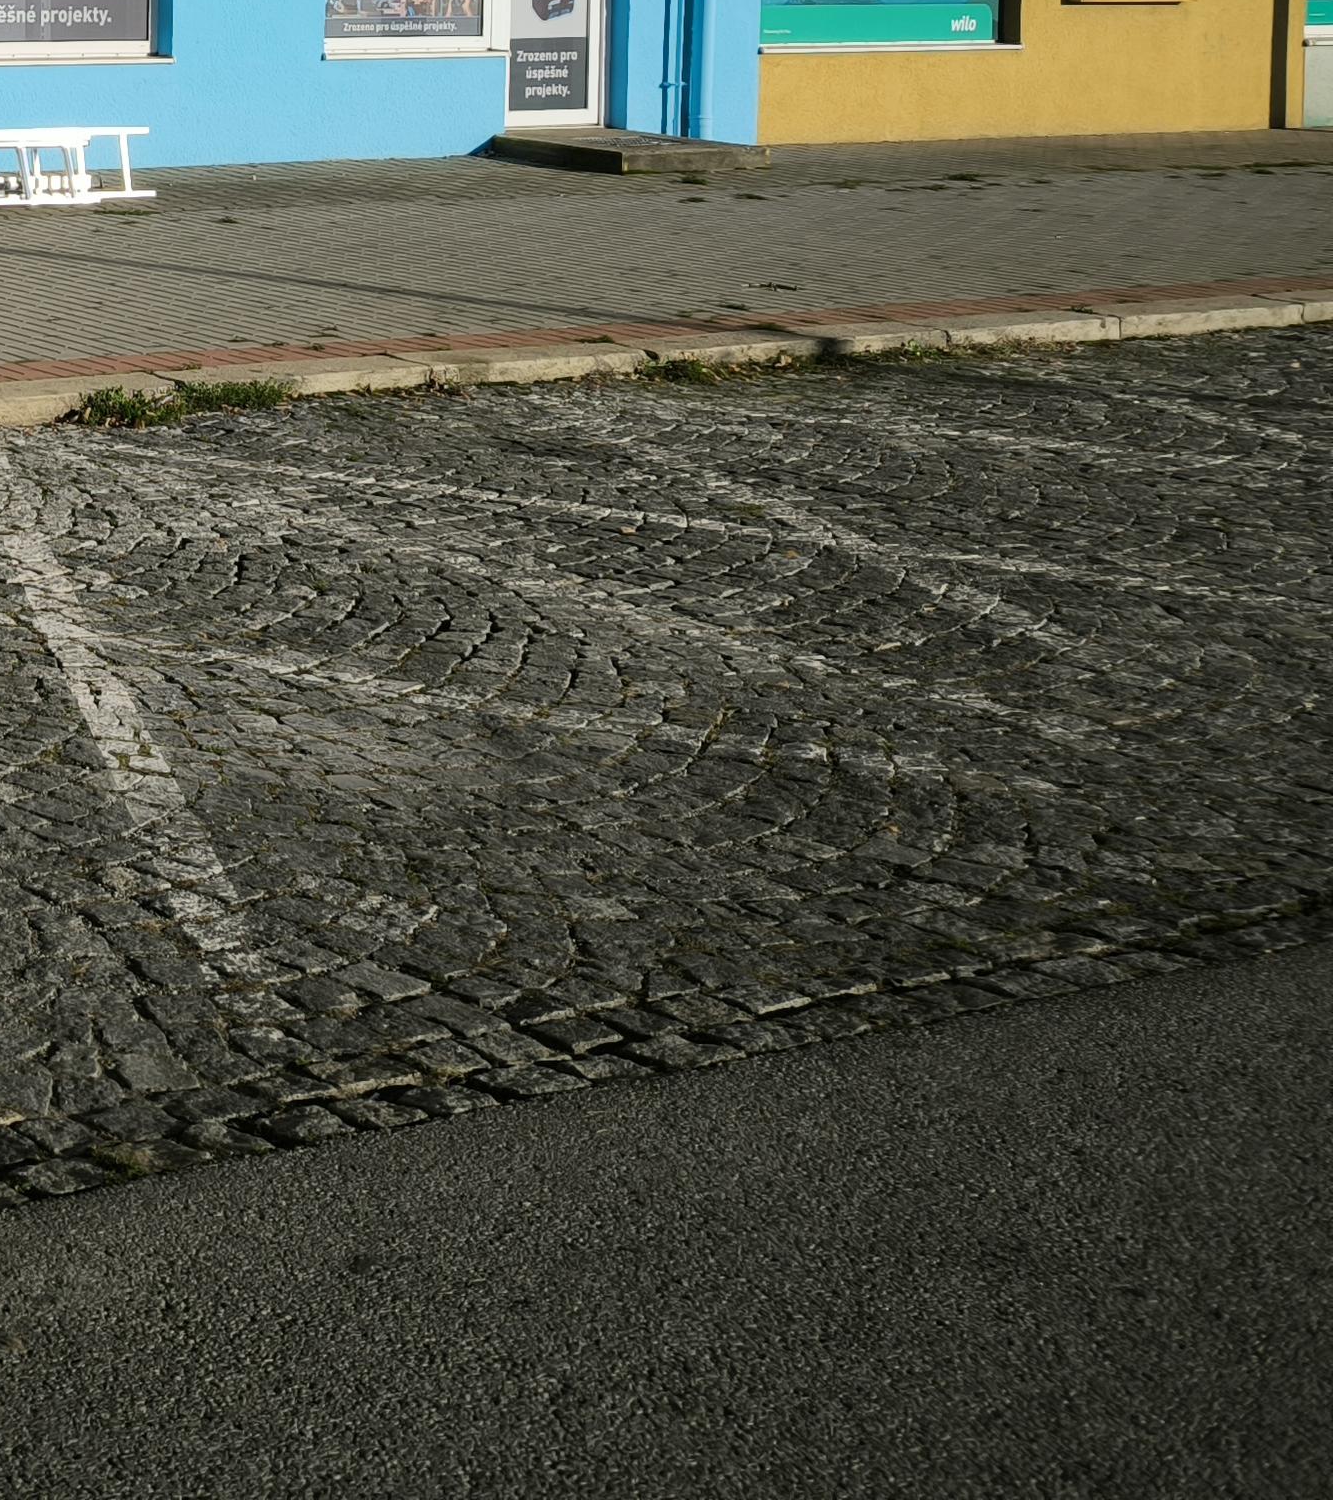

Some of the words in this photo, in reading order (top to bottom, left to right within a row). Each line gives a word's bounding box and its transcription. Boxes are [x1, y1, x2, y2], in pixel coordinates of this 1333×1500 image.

[40, 6, 113, 27] projekty.
[951, 15, 977, 32] wilo
[343, 22, 374, 32] Zrozeno
[376, 24, 389, 32] pro
[516, 50, 558, 62] Zrozeno
[560, 51, 578, 63] pro
[525, 64, 569, 81] úspěšné
[525, 83, 571, 99] projekty.
